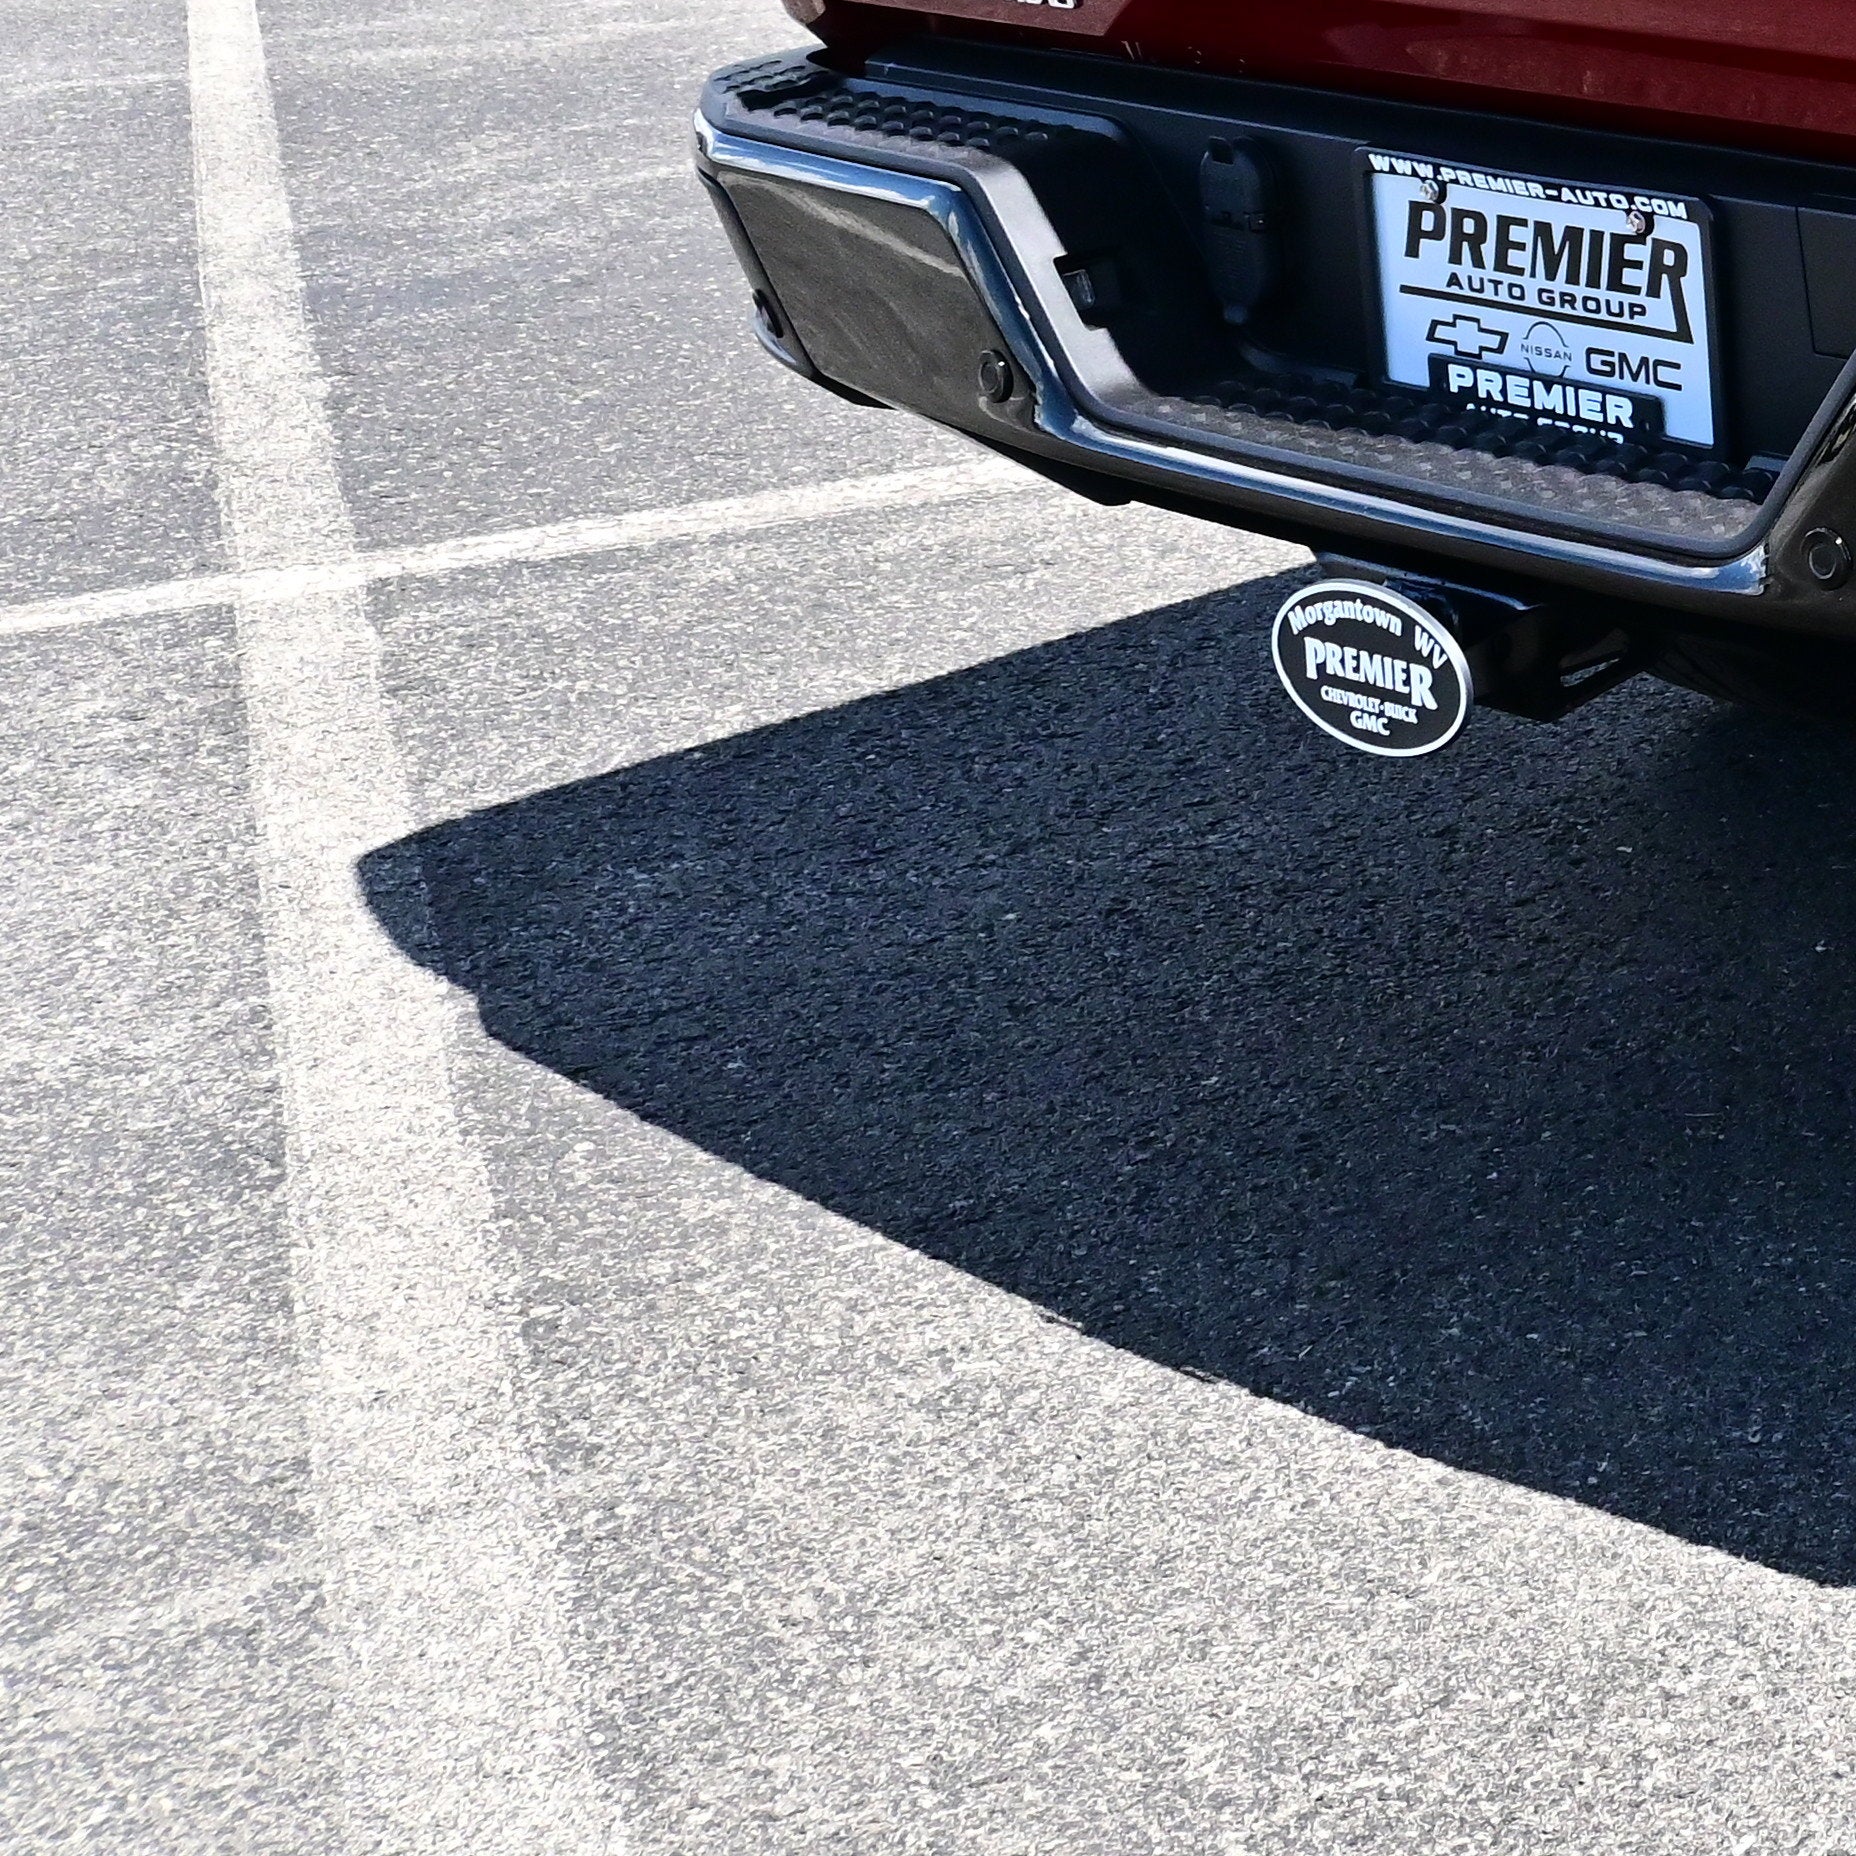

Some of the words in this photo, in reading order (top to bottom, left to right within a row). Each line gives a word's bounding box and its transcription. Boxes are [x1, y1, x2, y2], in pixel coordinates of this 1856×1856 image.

[1368, 153, 1688, 220] WWW.PREMIER-AUTO.COM
[1404, 200, 1691, 309] PREMIER
[1446, 272, 1526, 301] AUTO
[1537, 289, 1648, 320] GROUP
[1520, 342, 1573, 361] NISSAN
[1584, 347, 1683, 391] GMC
[1448, 364, 1634, 428] PREMIER
[1287, 598, 1402, 636] Morgantown
[1414, 625, 1448, 669] WV
[1304, 636, 1438, 710] PREMIER
[1350, 711, 1391, 736] GMC
